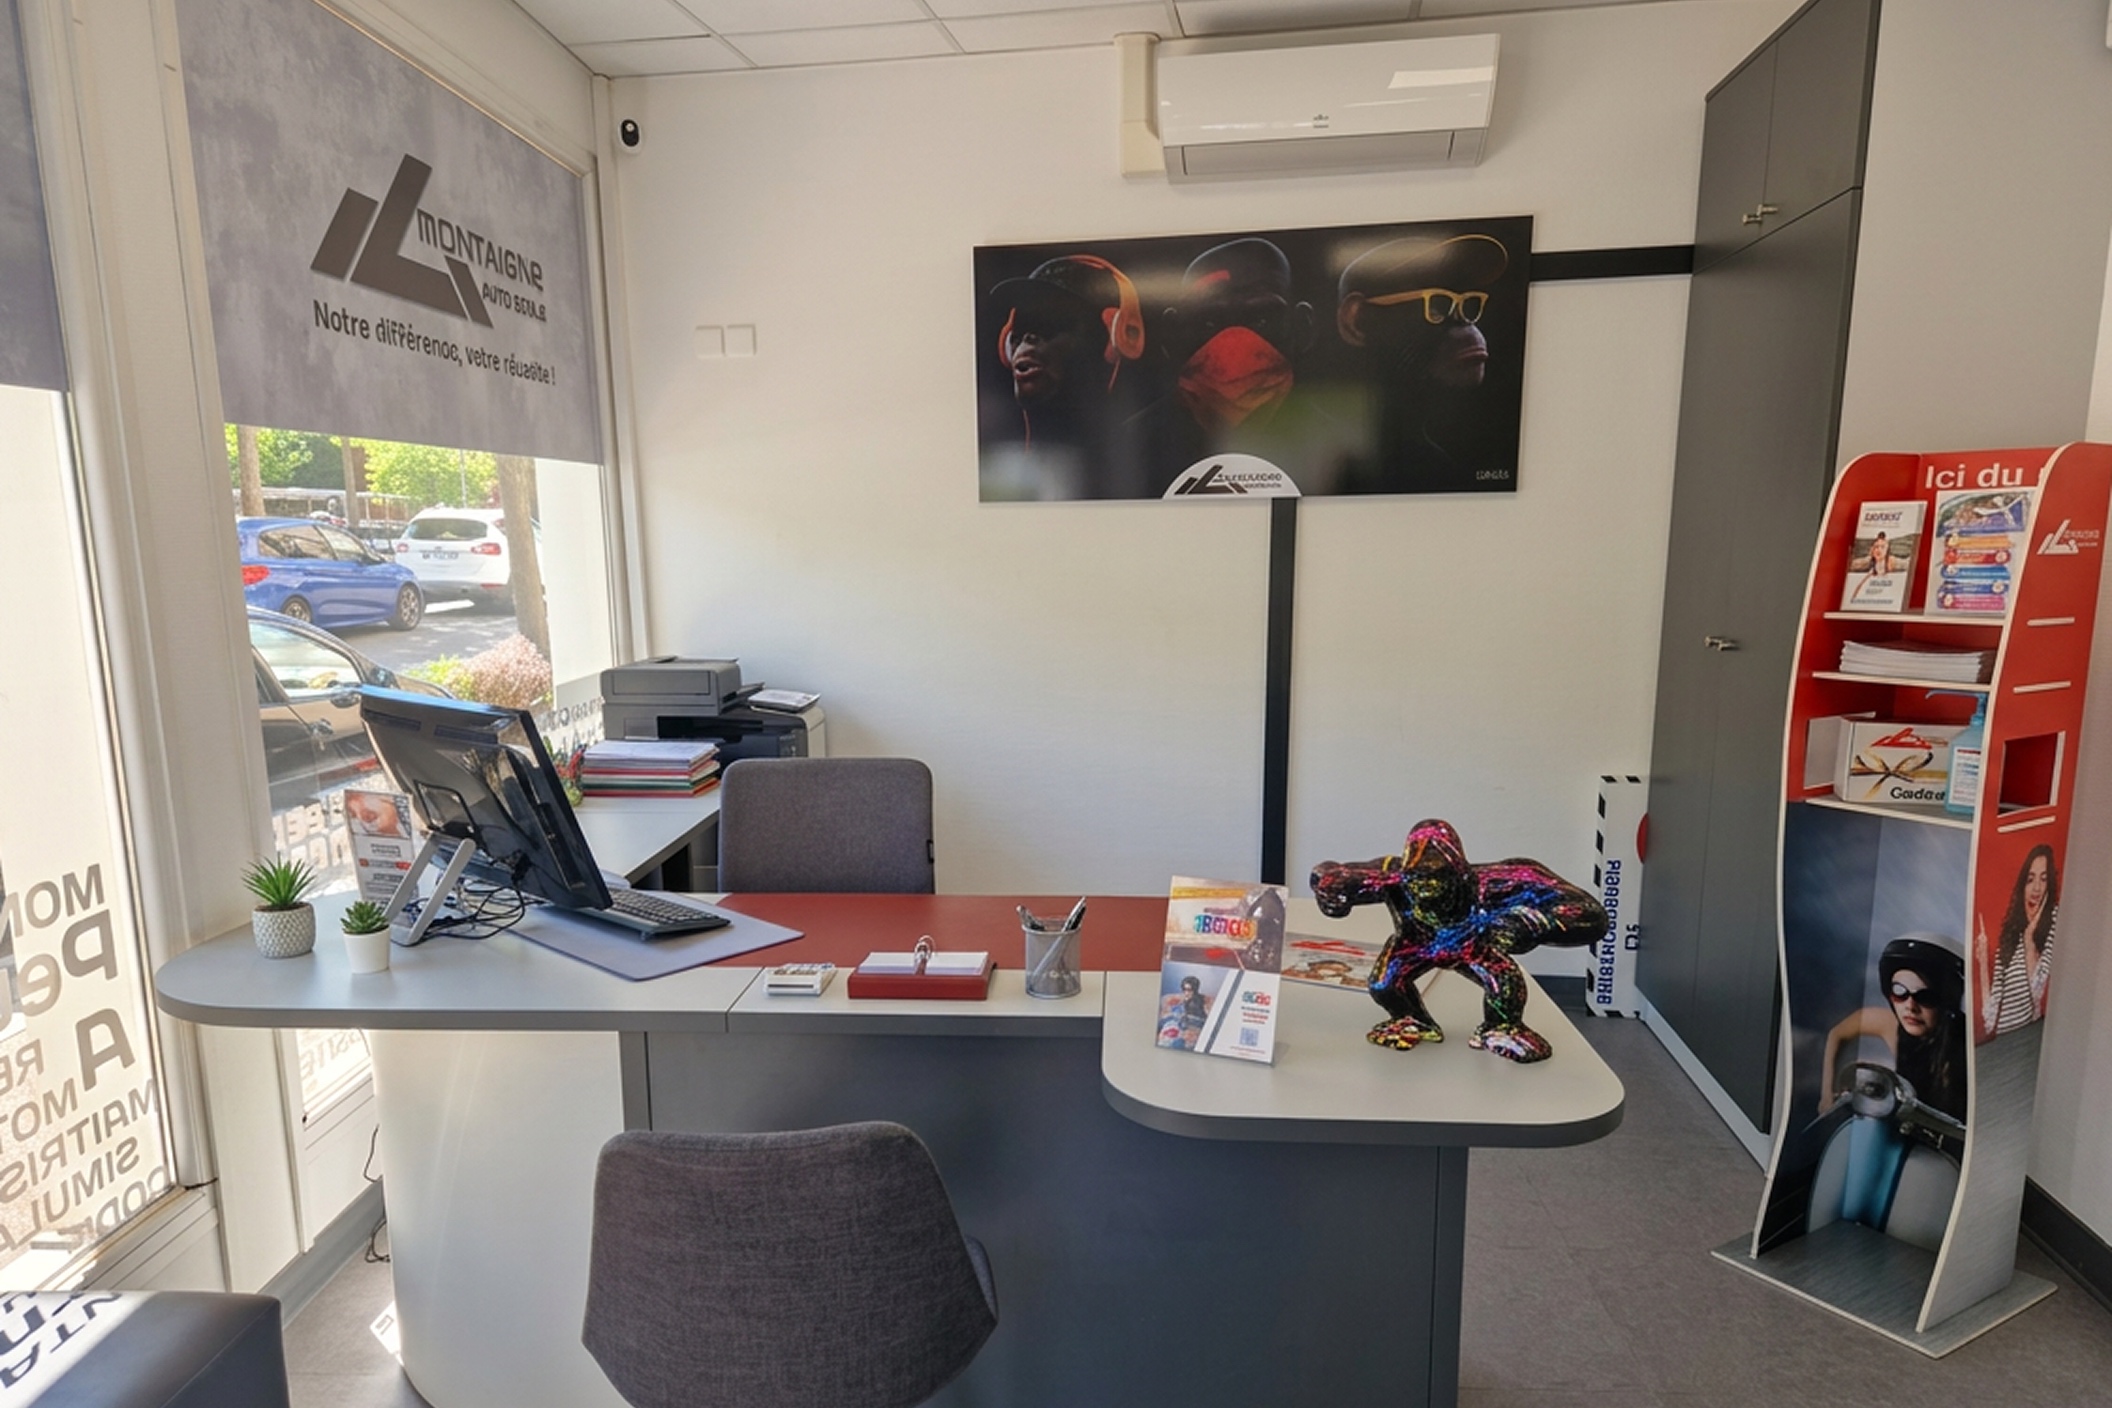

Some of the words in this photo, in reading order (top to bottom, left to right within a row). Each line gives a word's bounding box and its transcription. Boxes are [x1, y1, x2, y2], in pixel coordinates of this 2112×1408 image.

[482, 282, 512, 310] AUTO
[313, 299, 370, 339] Notre
[1924, 463, 1966, 489] Ici
[1976, 462, 2024, 488] du
